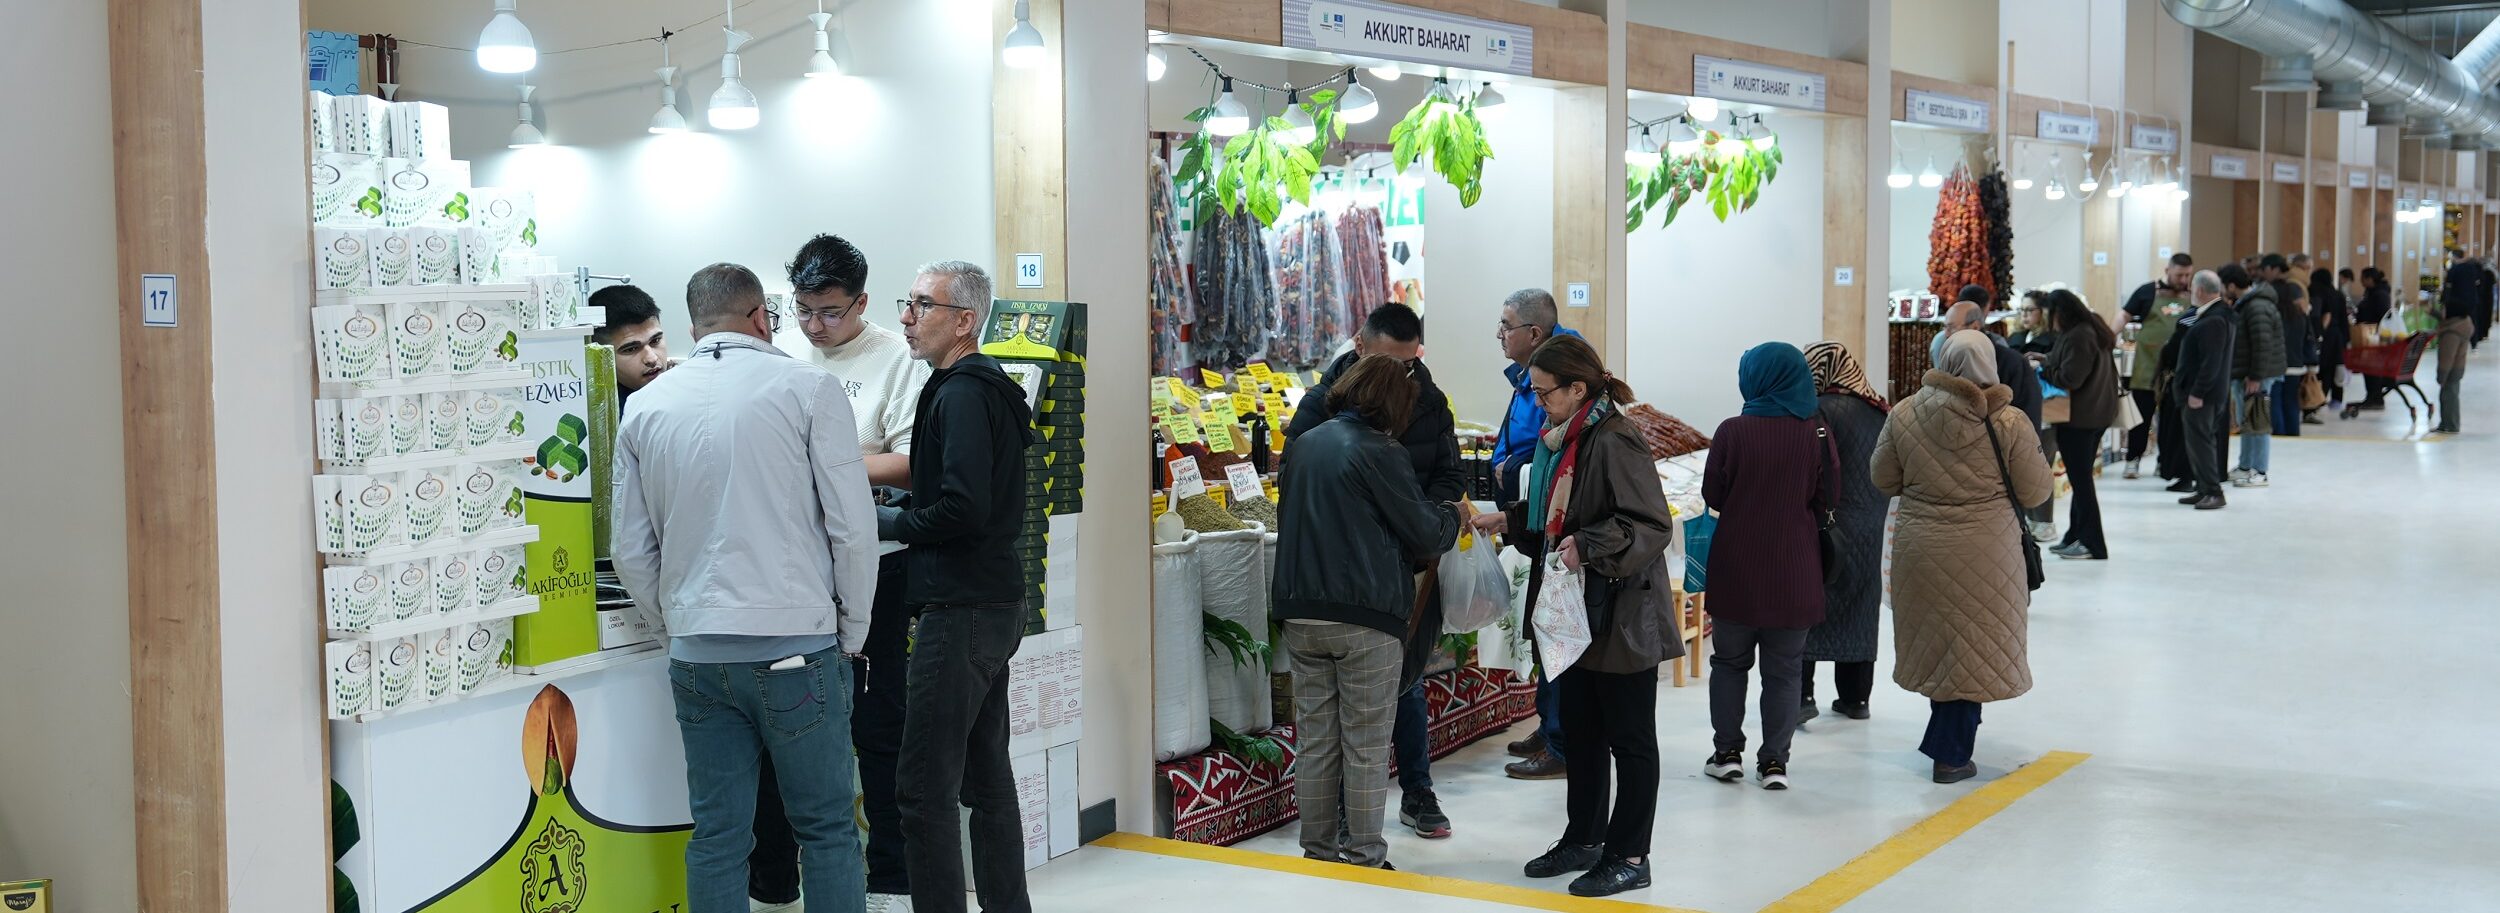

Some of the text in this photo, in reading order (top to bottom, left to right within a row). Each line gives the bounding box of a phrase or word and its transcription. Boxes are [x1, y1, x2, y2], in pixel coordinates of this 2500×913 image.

[1364, 20, 1470, 52] AKKURT BAHARAT
[1733, 75, 1790, 96] AKKURT BAHARAT
[1021, 263, 1036, 277] 18
[1838, 271, 1849, 281] 20
[150, 290, 168, 311] 17
[1572, 289, 1584, 300] 19
[526, 377, 583, 404] EZMESİ
[531, 570, 592, 596] AKİFOĞLU
[544, 587, 588, 602] REMIUM
[608, 621, 625, 630] LOKUM
[609, 615, 622, 623] ÖZEL
[539, 854, 568, 902] A
